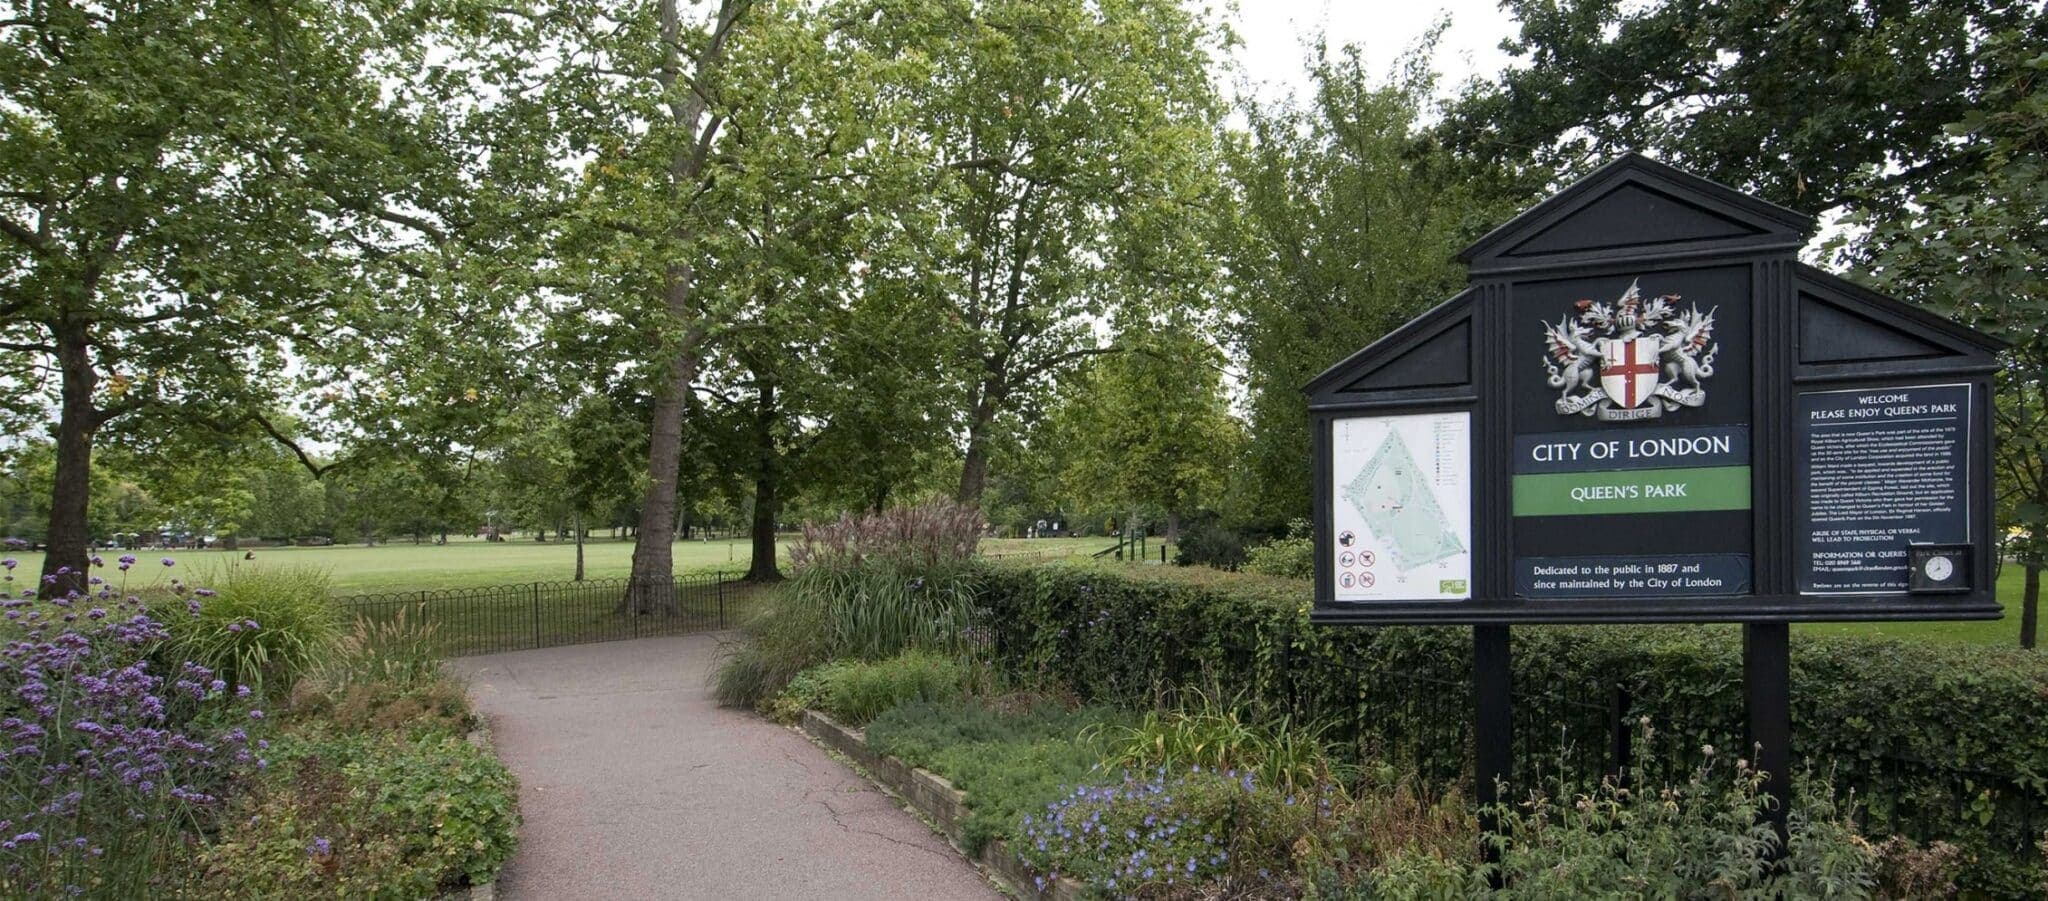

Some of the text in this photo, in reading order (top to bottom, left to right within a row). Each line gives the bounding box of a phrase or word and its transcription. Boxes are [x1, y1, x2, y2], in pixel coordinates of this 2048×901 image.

[1858, 394, 1909, 404] WELCOME
[1608, 409, 1652, 419] DIRIGE
[1811, 404, 1957, 419] PLEASE ENJOY QUEEN'S PARK
[1532, 435, 1730, 462] CITY OF LONDON
[1570, 483, 1687, 502] QUEEN'S PARK
[1812, 551, 1863, 559] INFORMATION
[1878, 550, 1907, 559] QUERIES
[1533, 563, 1700, 576] Dedicated to the public in 1887 and
[1533, 577, 1722, 589] since maintained by the City of London
